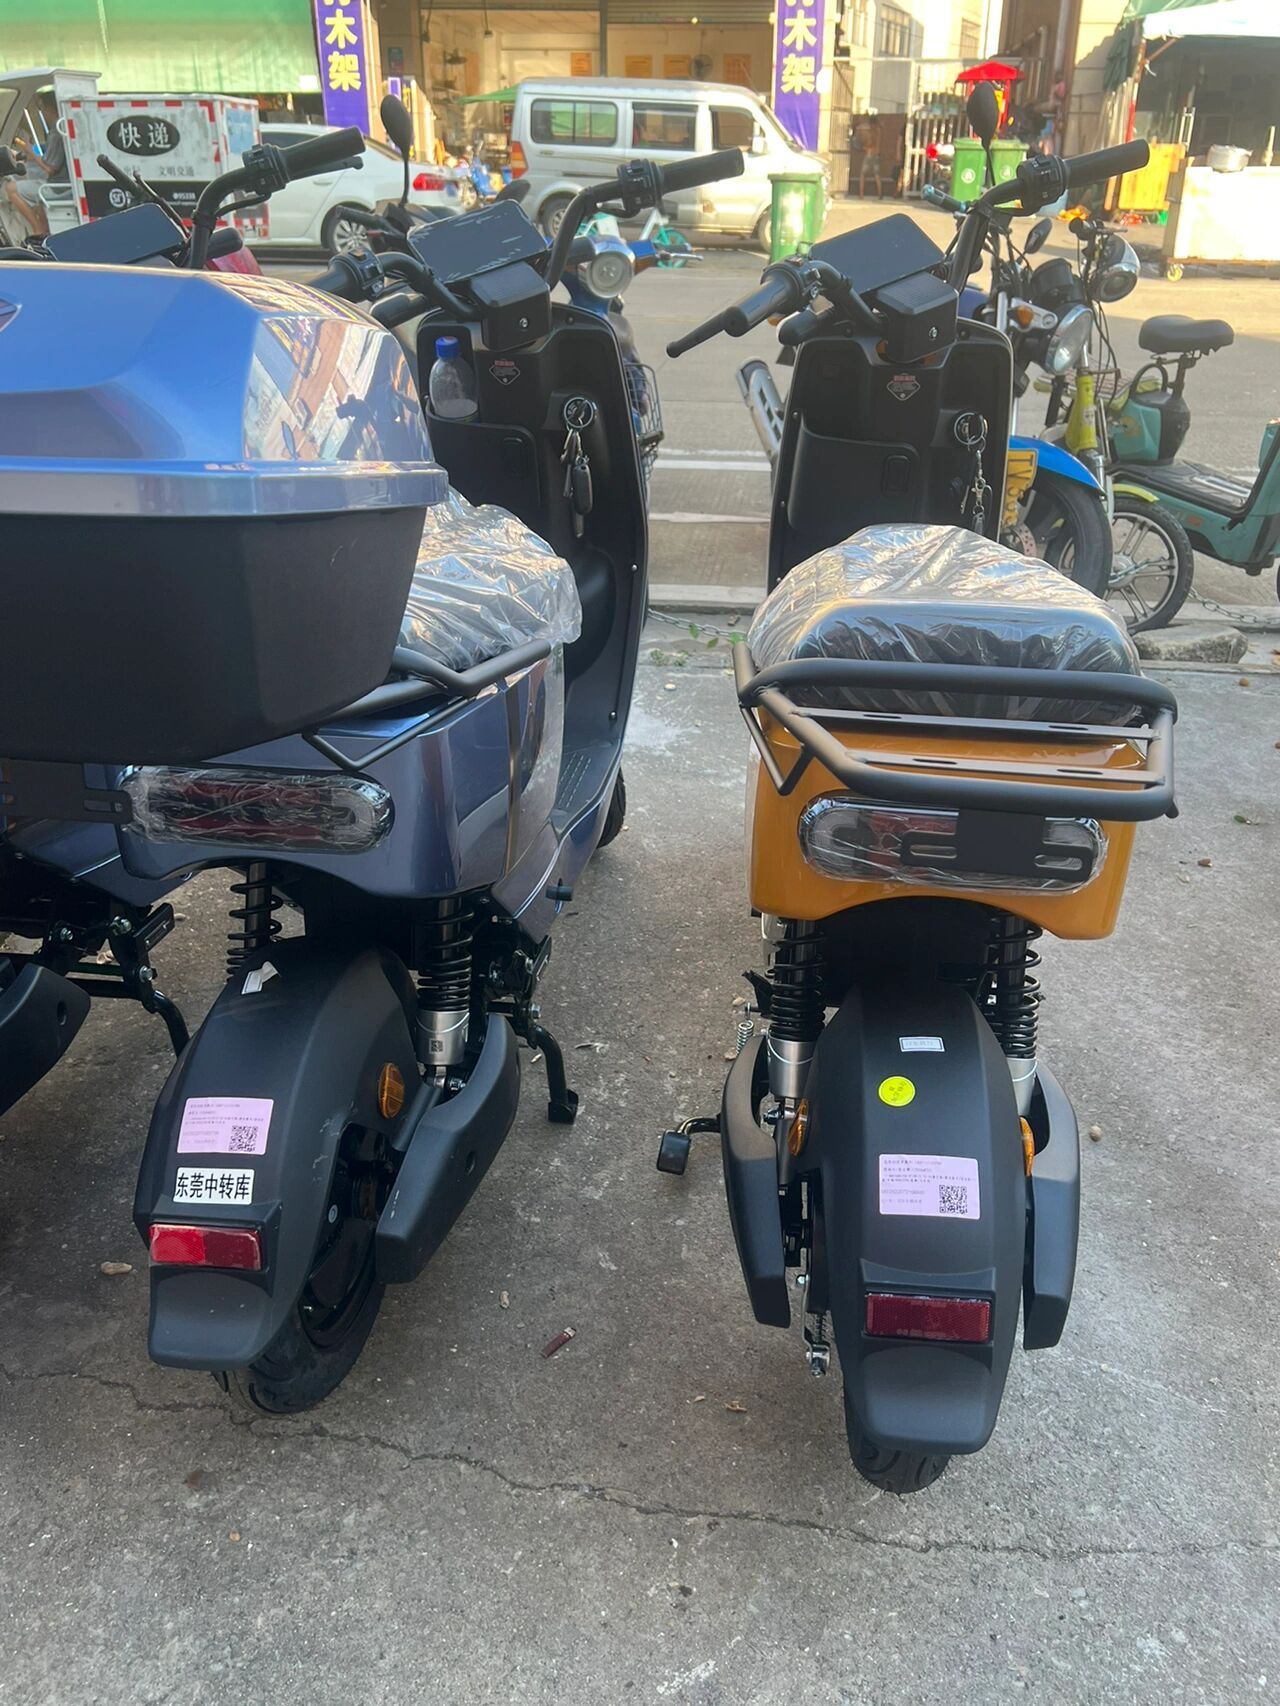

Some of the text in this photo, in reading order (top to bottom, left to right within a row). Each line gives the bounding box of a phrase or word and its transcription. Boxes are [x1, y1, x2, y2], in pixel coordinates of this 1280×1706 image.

[323, 0, 361, 92] 木架
[780, 0, 818, 95] 木架
[118, 122, 171, 149] 快递
[175, 1172, 251, 1200] 东莞中转库
